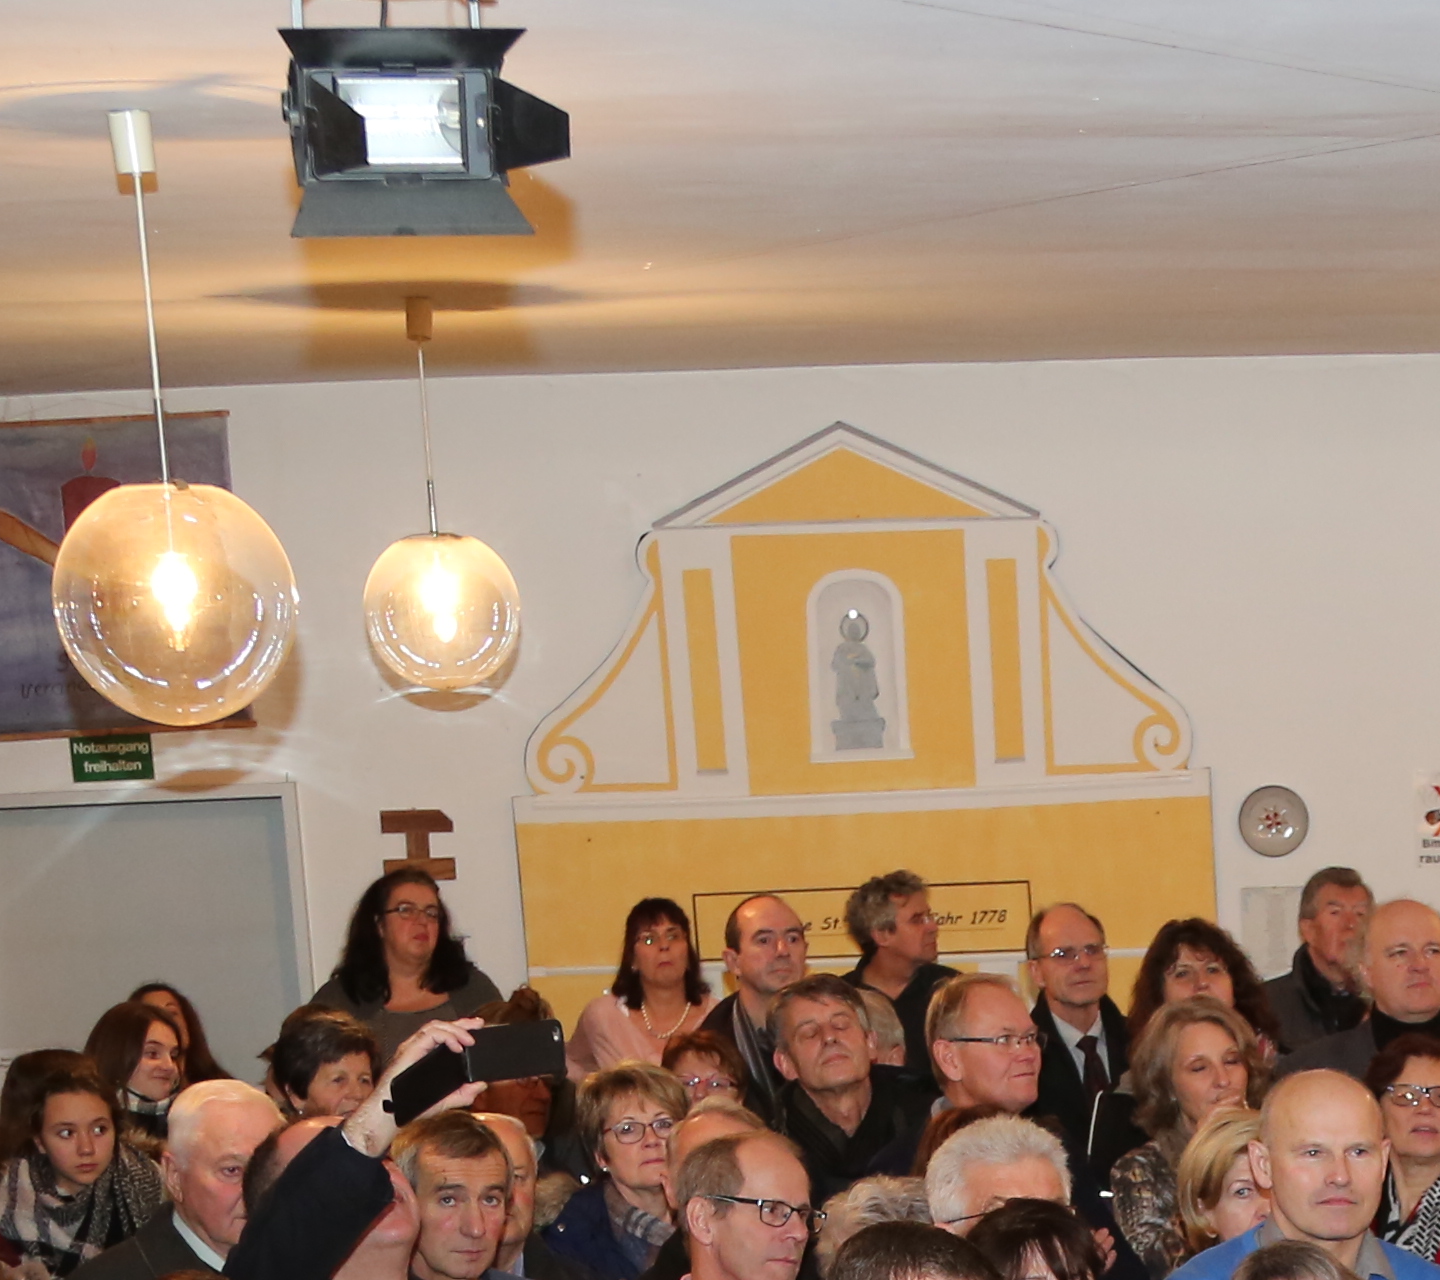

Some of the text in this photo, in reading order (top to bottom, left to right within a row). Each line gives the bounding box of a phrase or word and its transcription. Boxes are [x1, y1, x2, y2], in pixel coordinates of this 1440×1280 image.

[72, 742, 150, 755] Notausgang
[83, 760, 142, 773] freihalten
[970, 909, 1007, 925] 1778
